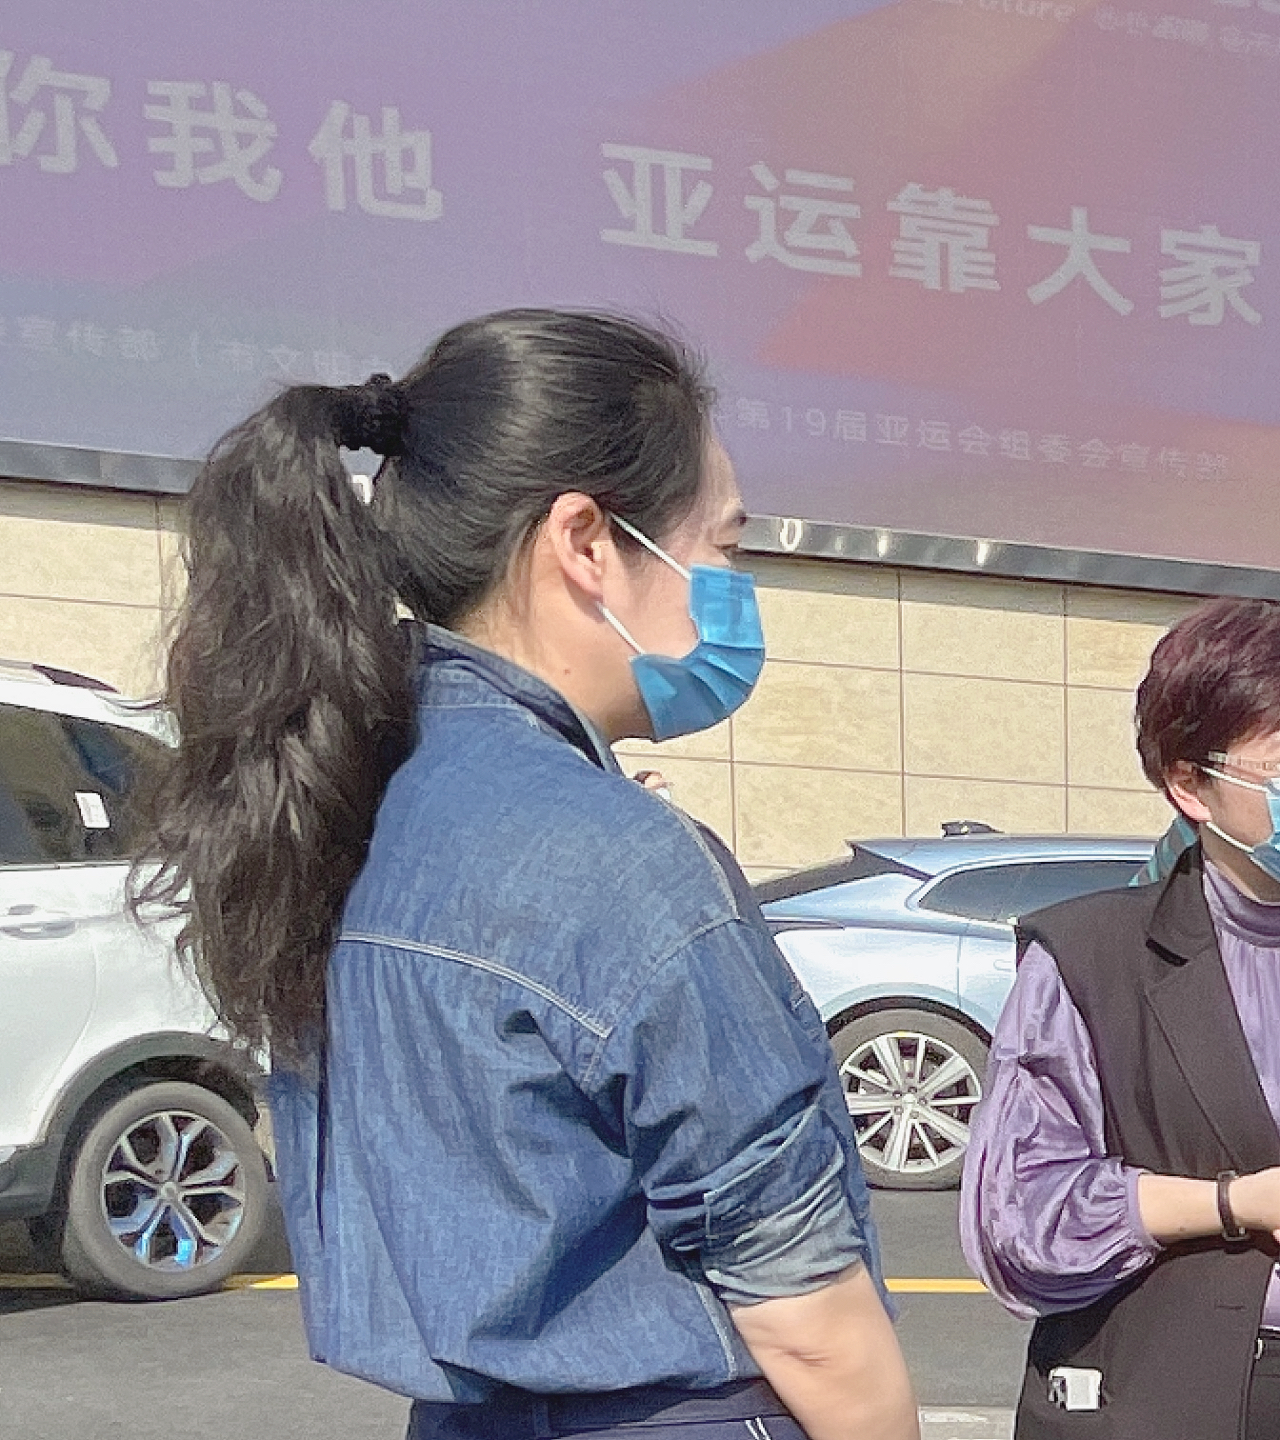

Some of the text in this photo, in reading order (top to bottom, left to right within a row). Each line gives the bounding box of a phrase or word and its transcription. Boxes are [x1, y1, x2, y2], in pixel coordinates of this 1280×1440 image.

[0, 50, 1262, 327] 你我他 亚运靠大家
